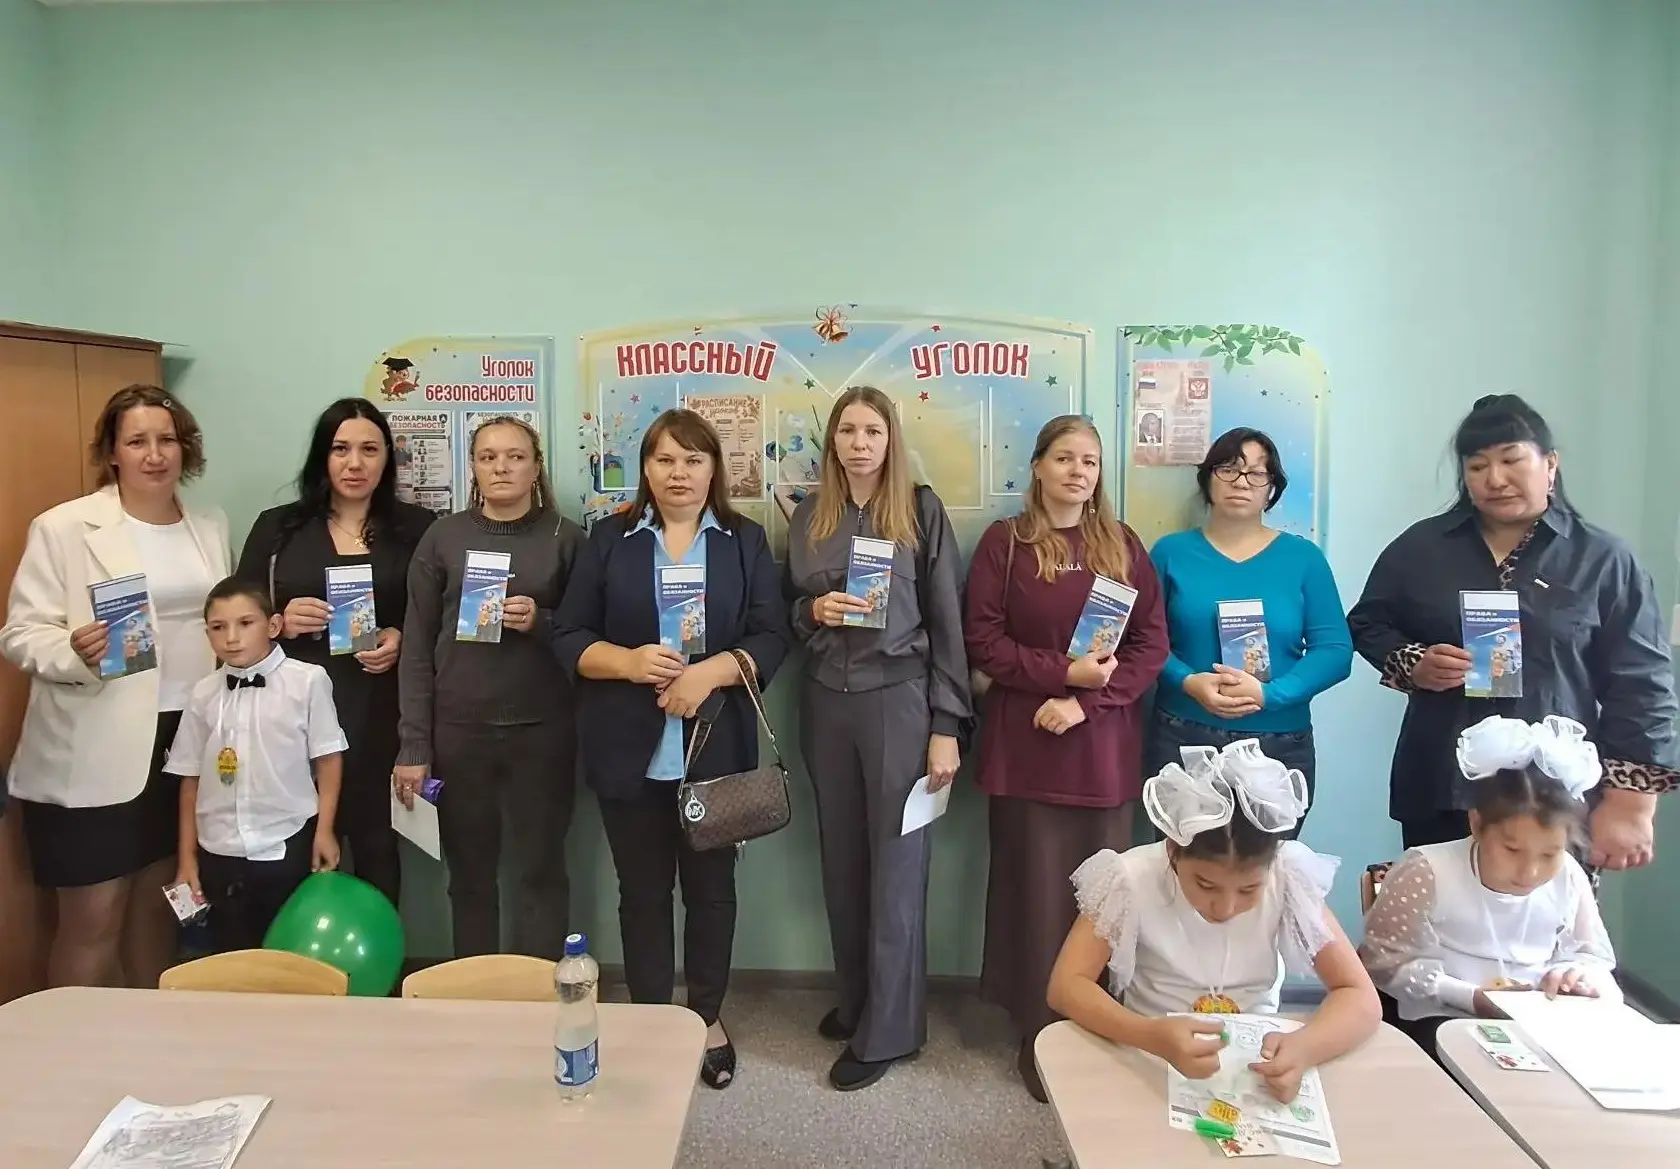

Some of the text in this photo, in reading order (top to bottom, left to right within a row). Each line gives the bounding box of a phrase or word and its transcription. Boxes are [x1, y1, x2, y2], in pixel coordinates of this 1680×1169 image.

[481, 355, 534, 378] Уголок
[616, 340, 1029, 382] КЛАССНЫЙ УГОЛОК
[425, 384, 535, 402] безопасности
